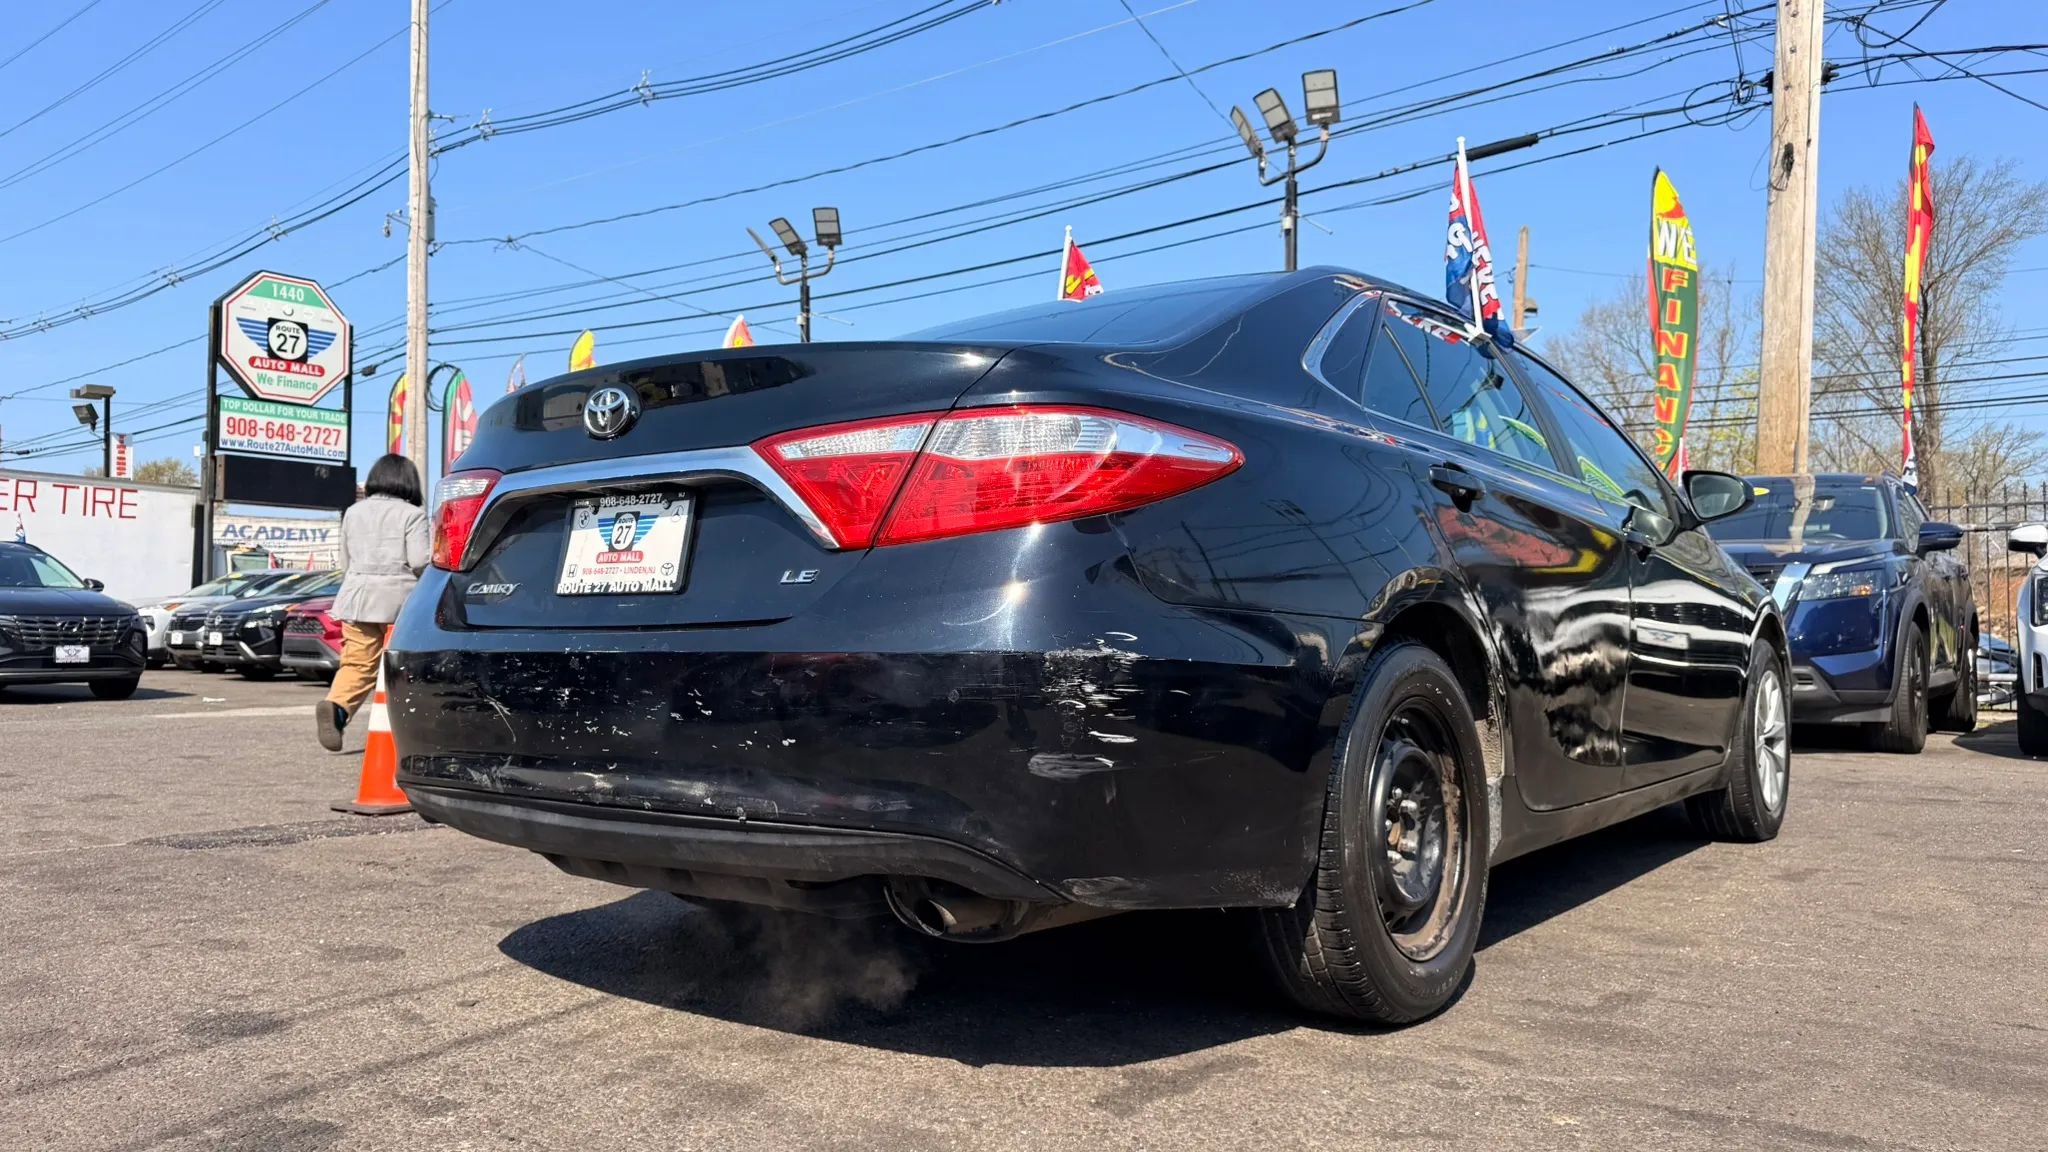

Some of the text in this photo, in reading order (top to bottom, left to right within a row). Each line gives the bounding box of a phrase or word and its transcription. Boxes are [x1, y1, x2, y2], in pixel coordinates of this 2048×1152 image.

[272, 283, 304, 302] 1440
[276, 325, 300, 335] ROUTE
[276, 333, 300, 354] 27
[254, 357, 322, 376] AUTO MALL
[1652, 267, 1689, 471] FINANC
[257, 373, 318, 391] We Finance
[223, 400, 346, 423] TOP DOLLAR FOR YOUR TRADE
[226, 416, 341, 446] 908-648-2727
[221, 438, 345, 458] www.Route27AutoMall.com
[52, 483, 138, 519] TIRE
[600, 493, 663, 507] 908-648-2727
[222, 524, 330, 542] ACADEMY
[614, 525, 633, 545] 27
[598, 551, 641, 563] AUTO MALL
[780, 569, 818, 584] LE
[556, 579, 674, 594] ROUTE 27 AUTO MALL
